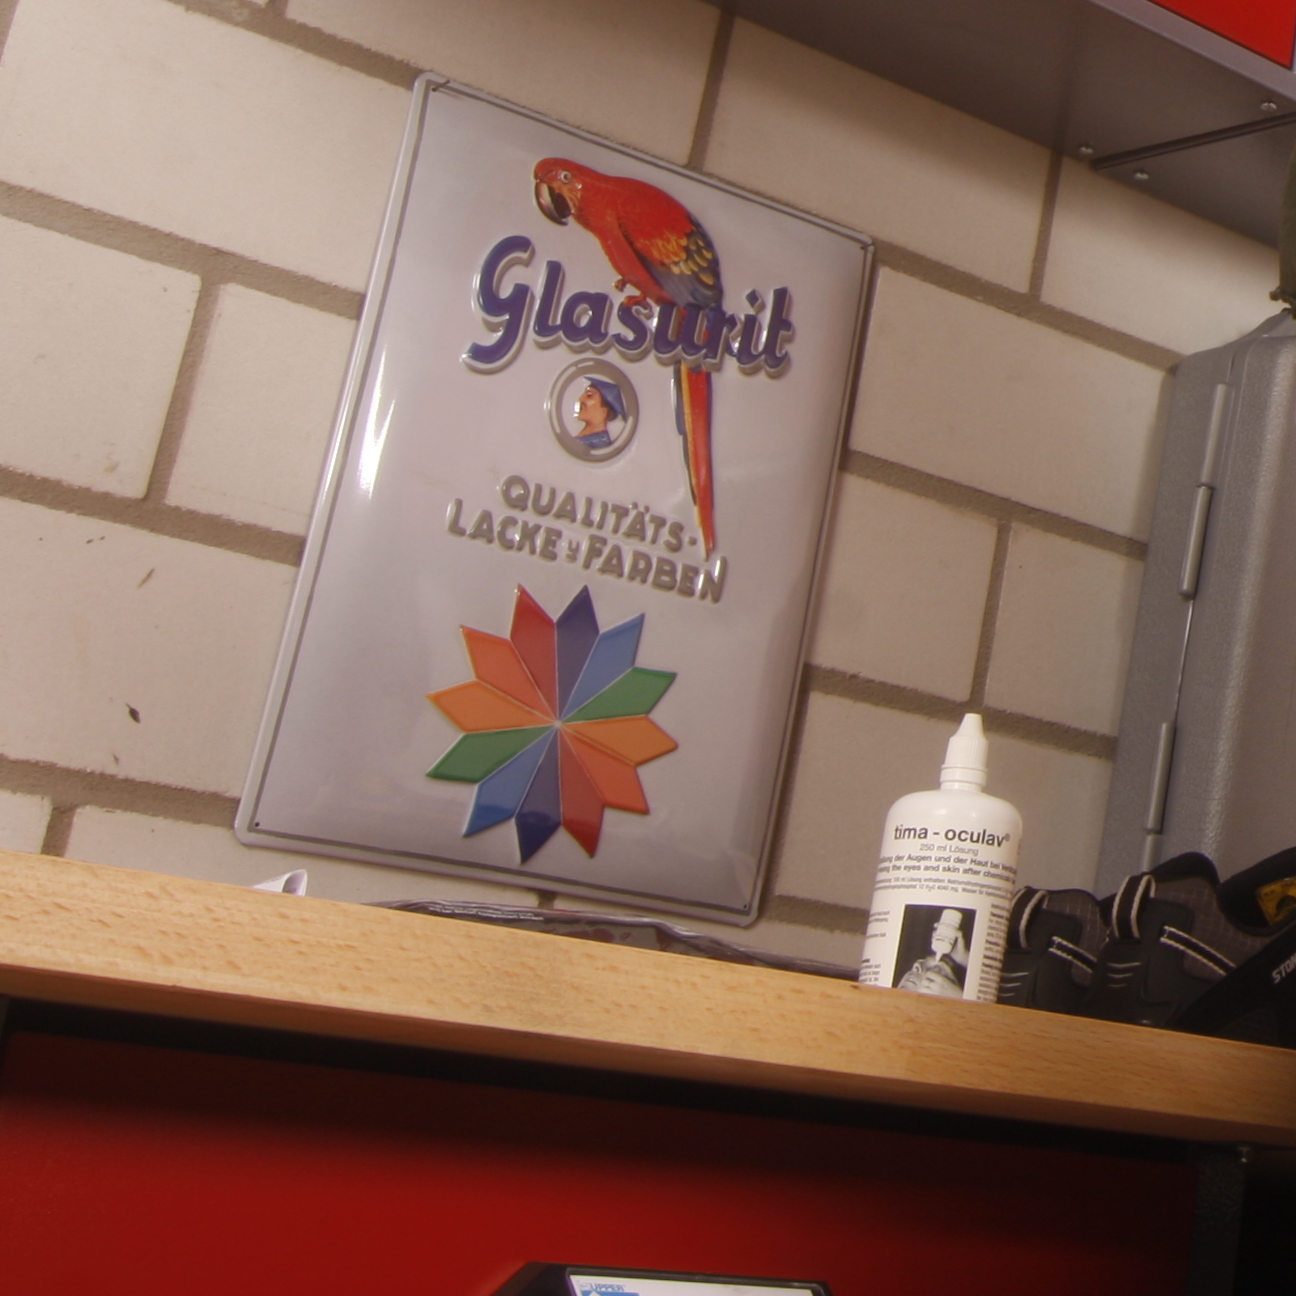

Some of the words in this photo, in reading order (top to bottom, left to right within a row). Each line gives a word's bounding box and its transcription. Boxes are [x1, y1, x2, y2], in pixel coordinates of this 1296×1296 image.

[463, 235, 795, 375] Glasurit
[446, 498, 563, 561] LACKE
[581, 533, 728, 604] FARBEN
[894, 824, 928, 840] tima
[919, 842, 934, 851] 250
[936, 844, 946, 852] ml
[949, 845, 979, 855] Lösung
[905, 853, 932, 864] Augen
[934, 854, 950, 862] und
[953, 855, 967, 864] der
[969, 857, 988, 866] Haut
[903, 863, 921, 873] eyes
[923, 863, 939, 872] and
[941, 865, 959, 873] skin
[962, 866, 981, 875] after
